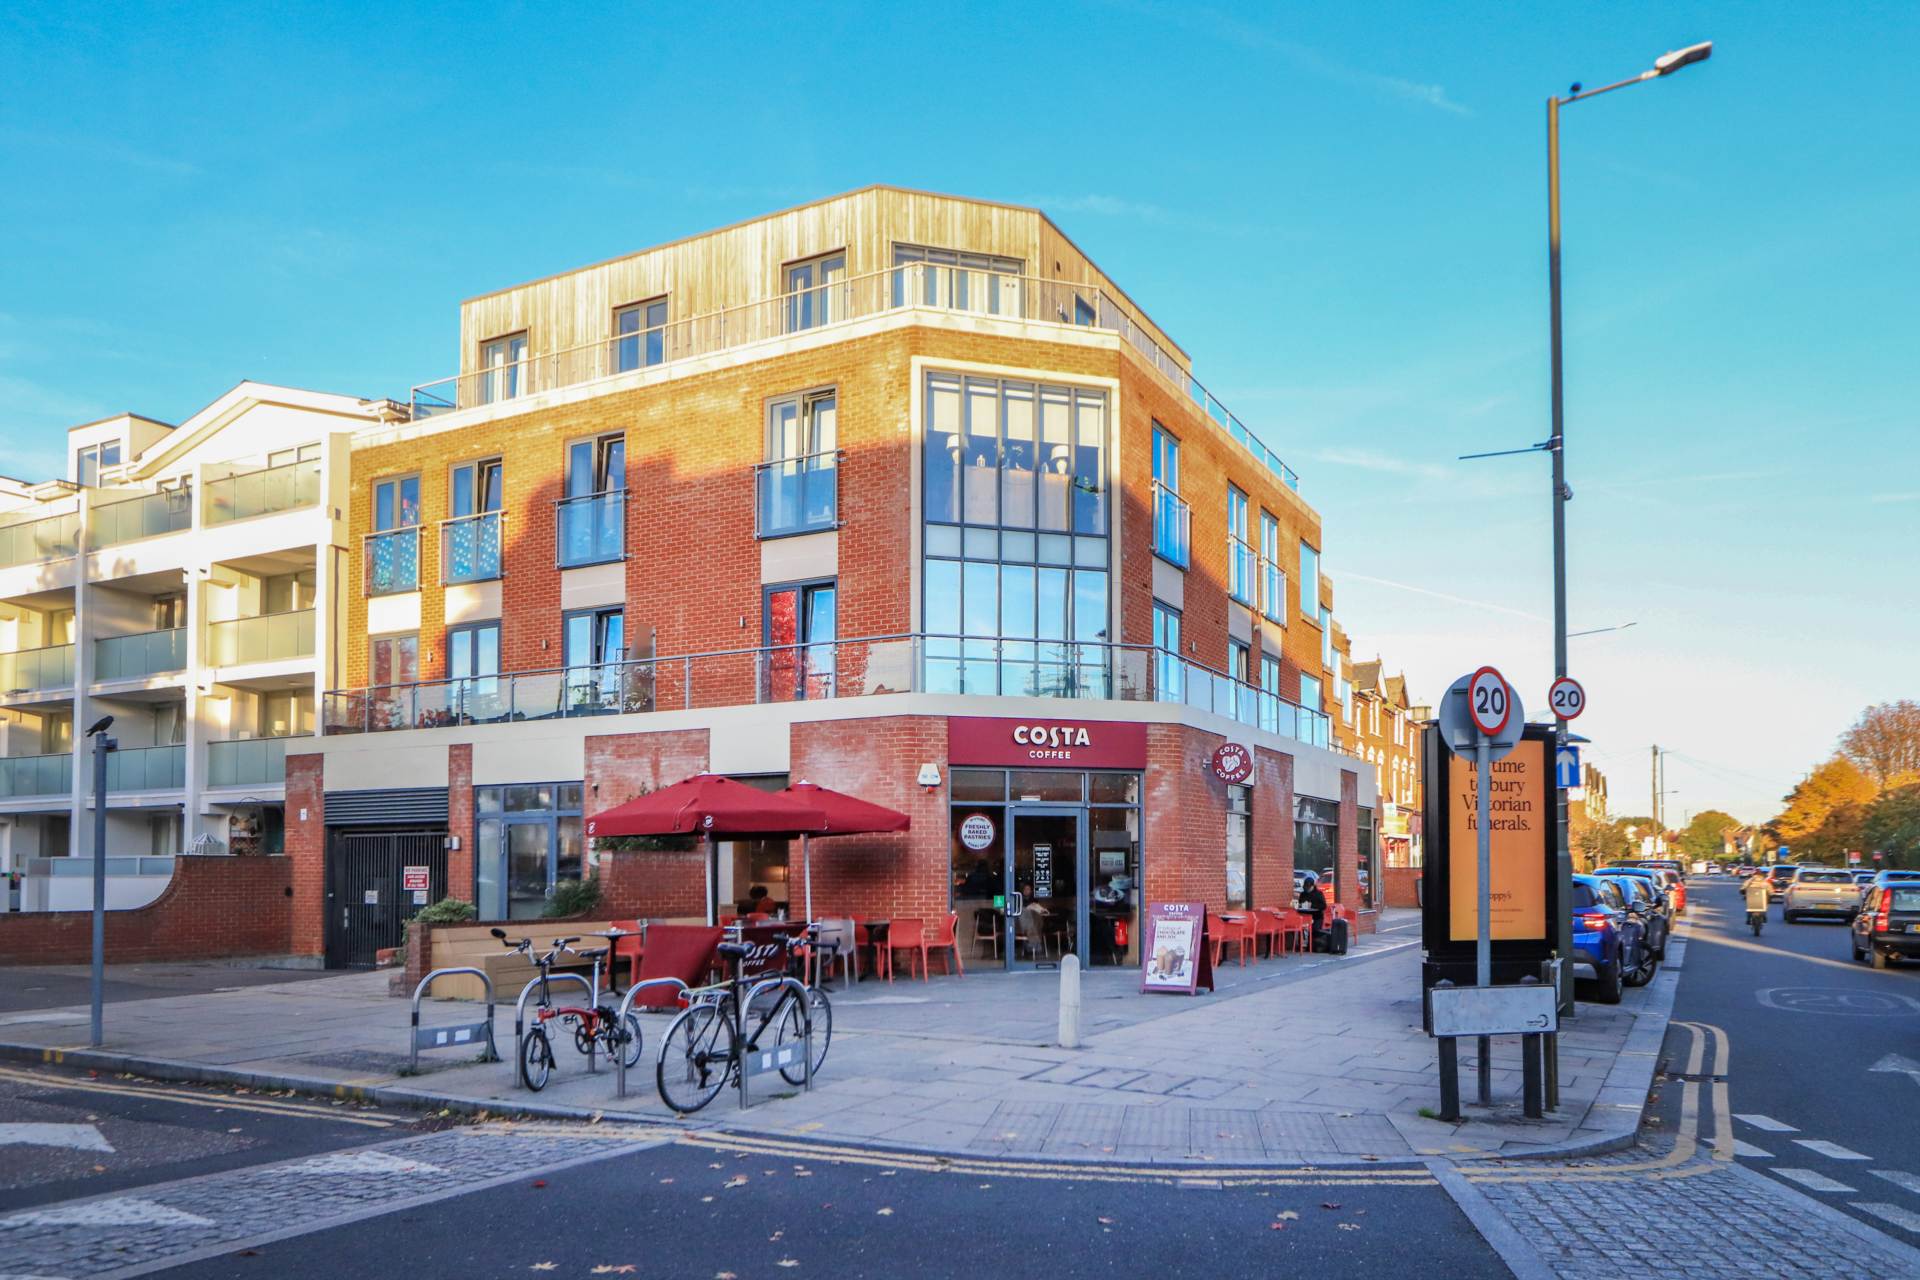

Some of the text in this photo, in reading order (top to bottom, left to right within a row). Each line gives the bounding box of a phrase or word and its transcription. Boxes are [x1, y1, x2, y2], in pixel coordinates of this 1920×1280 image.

[1476, 686, 1505, 715] 20
[1554, 690, 1580, 708] 20
[1014, 726, 1091, 748] COSTA
[1029, 750, 1071, 759] COFFEE
[1219, 745, 1244, 757] COSTA
[1492, 760, 1525, 773] time
[1216, 768, 1246, 780] COFFEE
[1490, 776, 1525, 796] bury
[1163, 904, 1189, 912] COSTA
